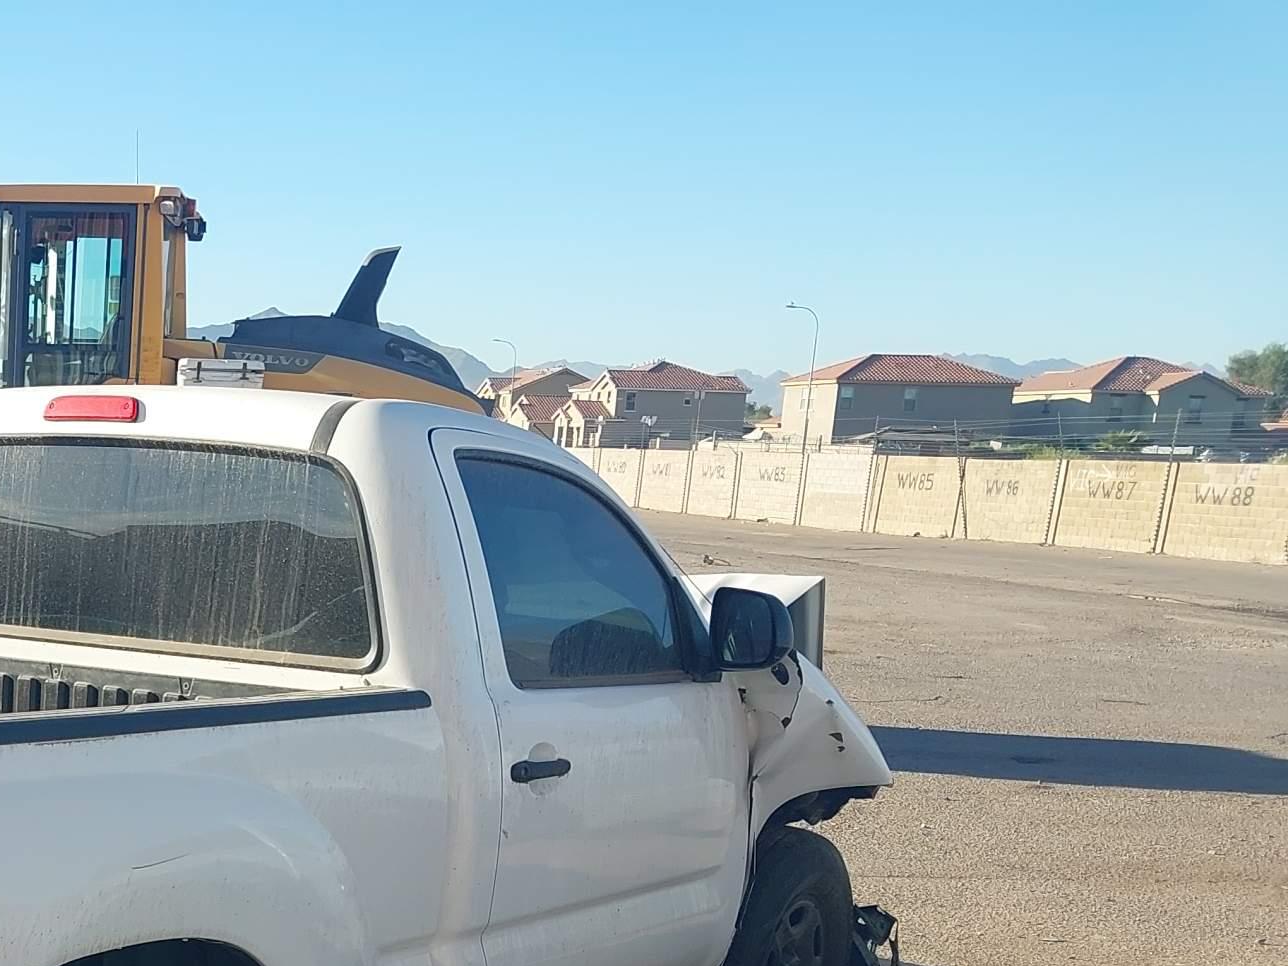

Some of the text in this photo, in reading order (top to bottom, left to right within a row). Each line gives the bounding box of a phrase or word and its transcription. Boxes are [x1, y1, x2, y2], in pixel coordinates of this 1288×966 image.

[232, 351, 309, 366] VOLVO
[759, 466, 785, 482] WW83
[897, 473, 935, 491] WW85
[1088, 480, 1137, 500] WW87
[1195, 484, 1255, 506] WW88
